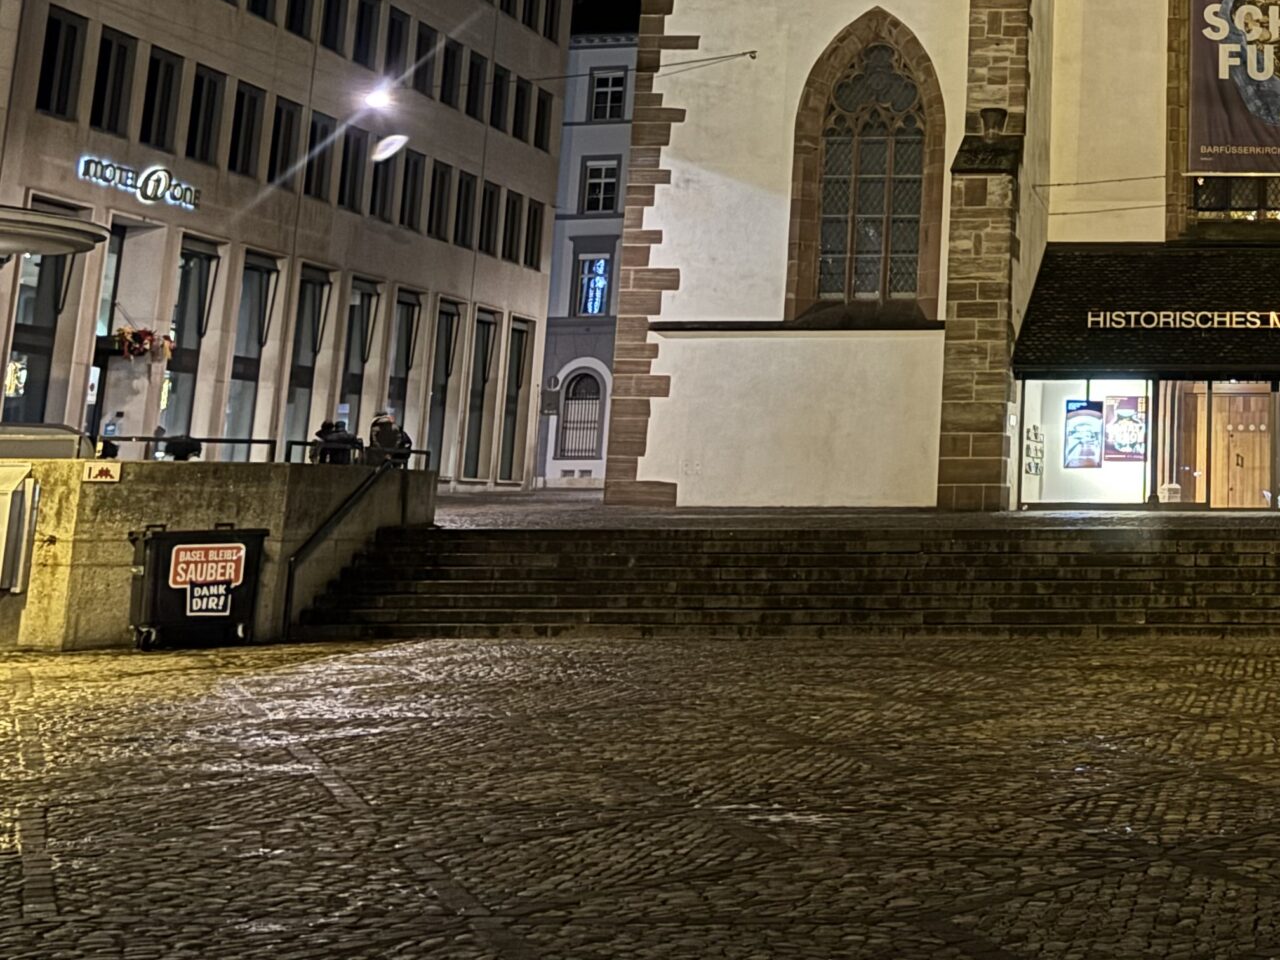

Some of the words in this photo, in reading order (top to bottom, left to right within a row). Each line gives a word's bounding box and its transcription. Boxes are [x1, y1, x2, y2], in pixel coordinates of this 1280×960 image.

[1087, 311, 1261, 329] HISTORISCHES
[179, 550, 206, 562] BASEL
[208, 549, 237, 561] BLEIBT
[176, 562, 236, 582] SAUBER
[193, 584, 227, 597] DANK
[192, 595, 226, 611] DIR!
